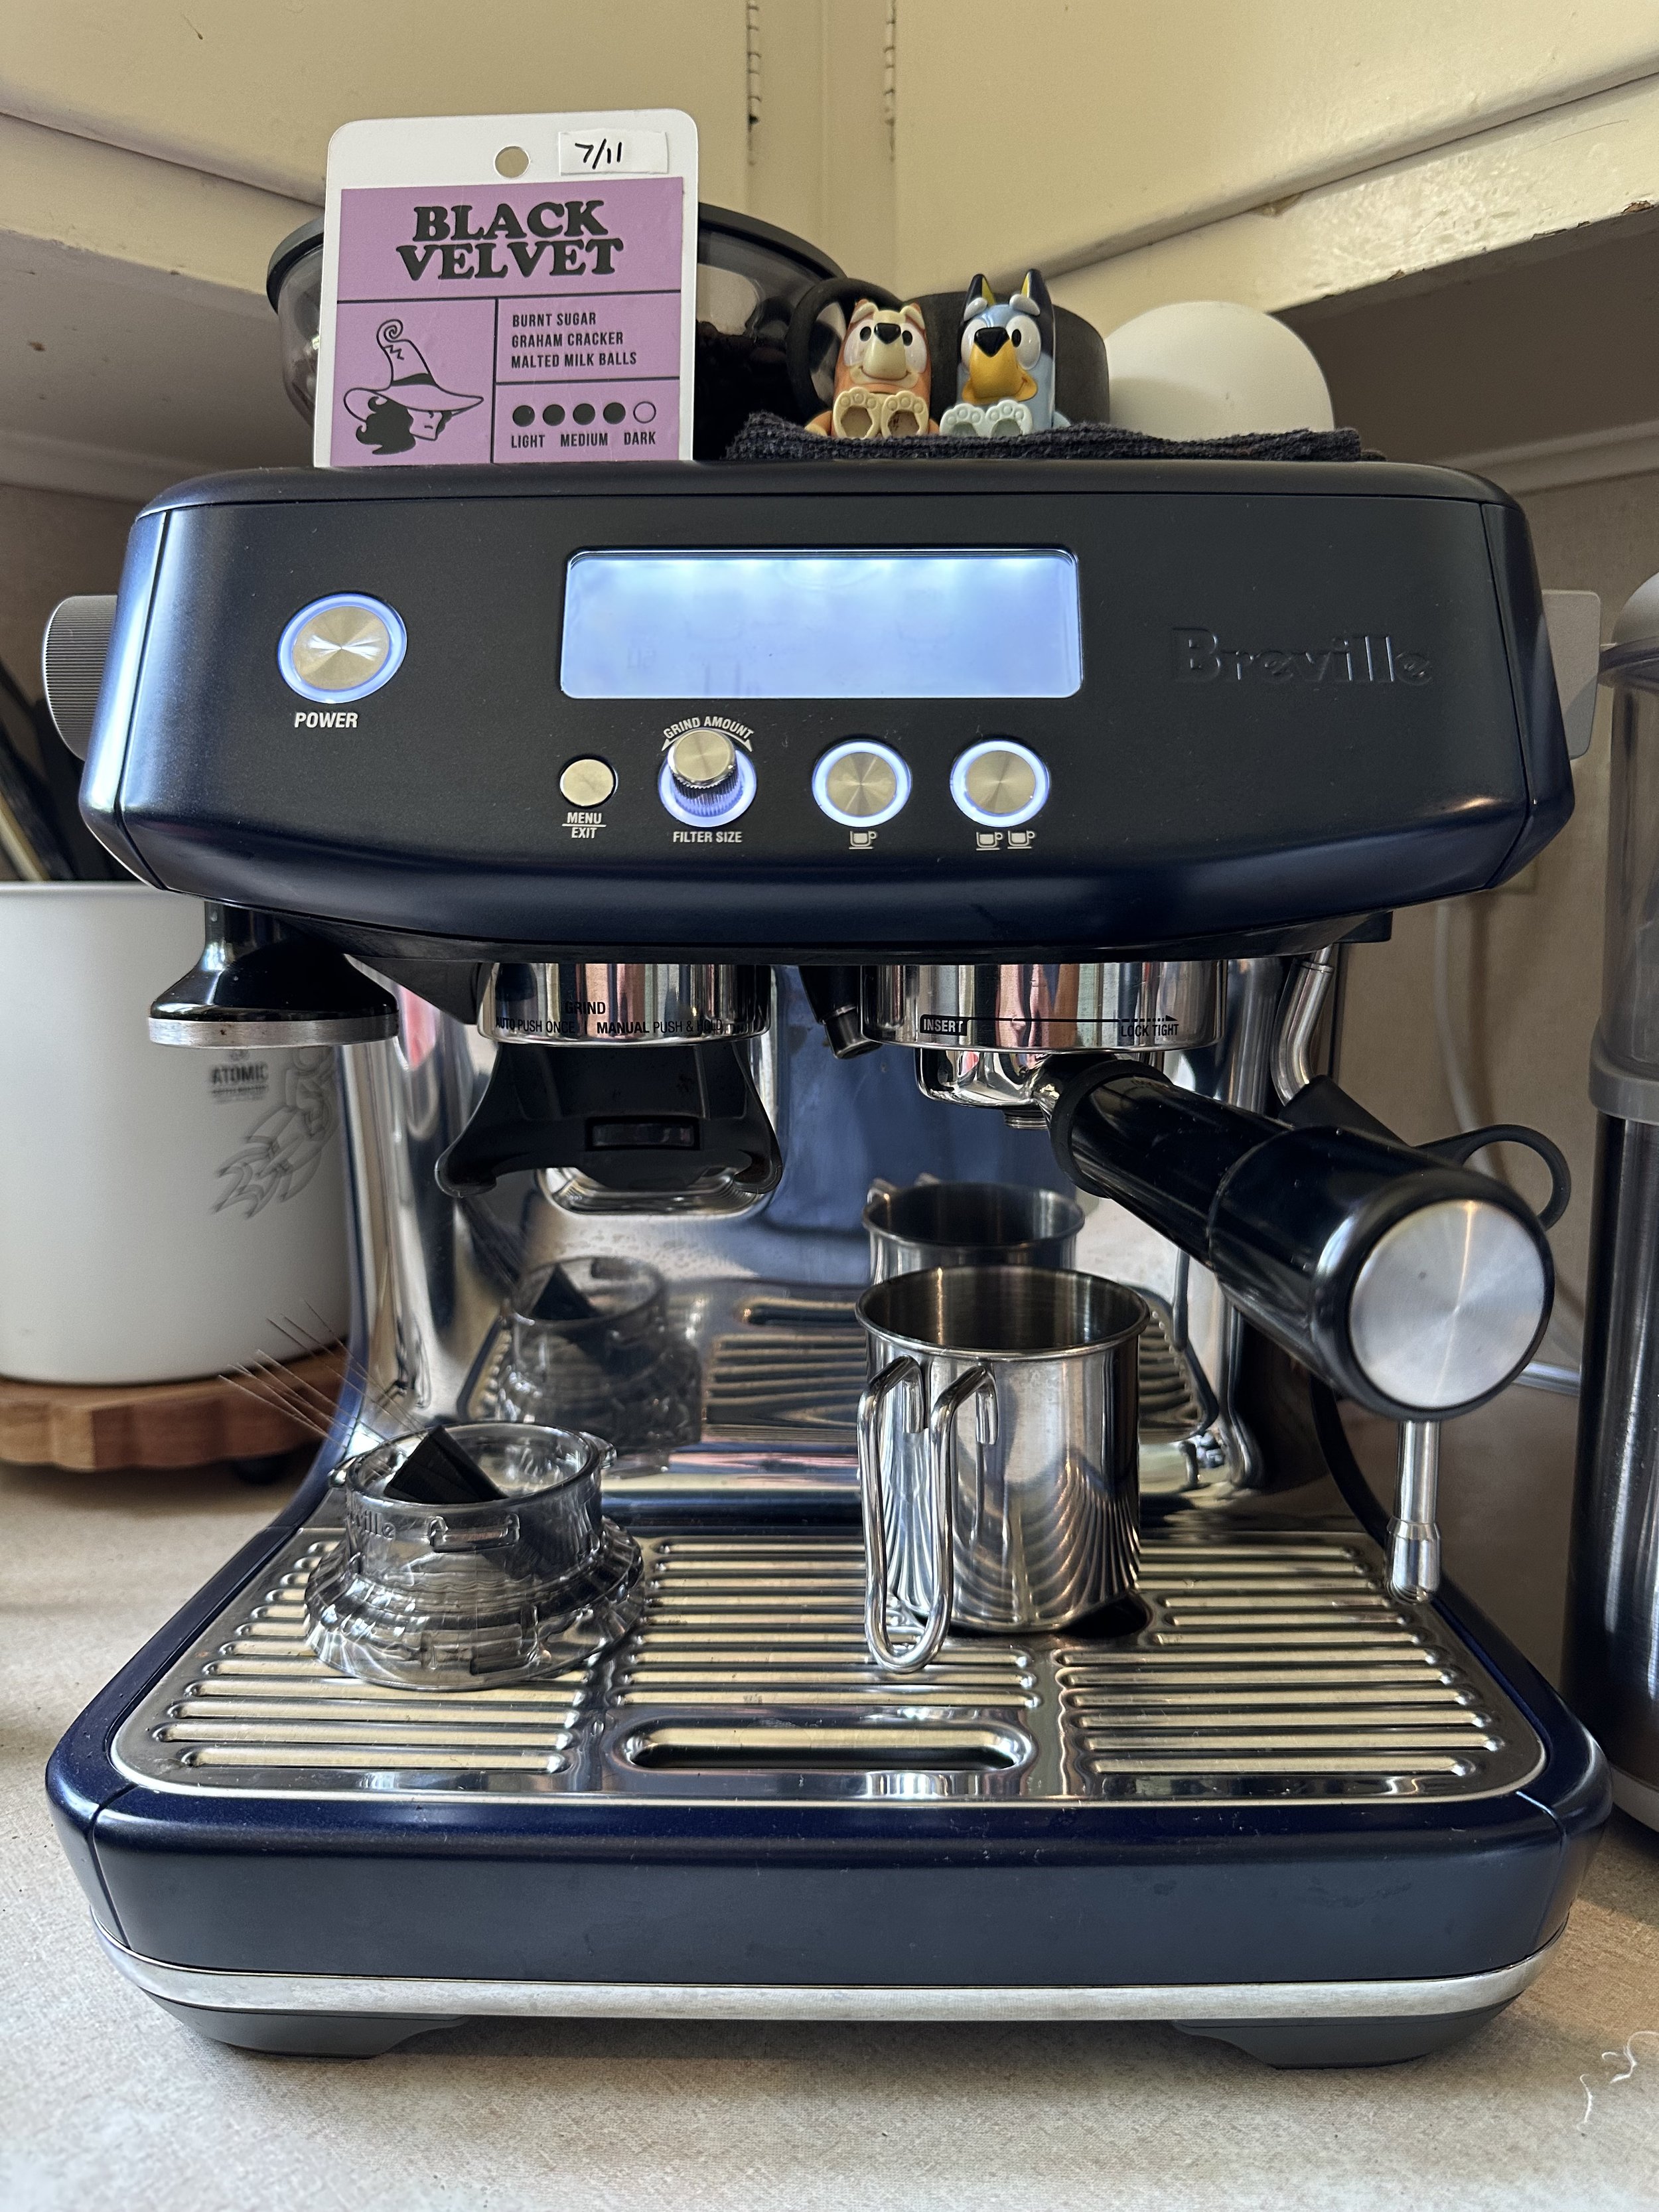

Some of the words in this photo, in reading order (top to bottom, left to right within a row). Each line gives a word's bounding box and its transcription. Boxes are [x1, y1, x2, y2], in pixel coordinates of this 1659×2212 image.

[574, 139, 622, 169] 7/11
[412, 200, 609, 242] BLACK
[396, 238, 624, 281] VELVET
[512, 313, 552, 327] BURNT
[557, 312, 596, 326] SUGAR
[512, 334, 563, 348] GRAHAM
[567, 332, 623, 346] CRACKER
[511, 354, 559, 369] MALTED
[564, 354, 594, 367] MILK
[599, 352, 637, 366] BALLS
[510, 433, 545, 449] LIGHT
[560, 432, 608, 447] MEDIUM
[624, 431, 656, 445] DARK
[1171, 627, 1433, 686] Breville
[294, 711, 358, 729] POWER
[663, 717, 701, 739] GRIND
[703, 715, 755, 739] AMOUNT
[567, 812, 602, 825] MENU
[571, 826, 597, 839] EXIT
[673, 831, 713, 843] FILTER
[717, 831, 742, 843] SIZE
[564, 1001, 606, 1015] GRIND
[496, 1017, 516, 1030] AUTO
[518, 1019, 542, 1033] PUSH
[545, 1020, 575, 1034] ONCE
[597, 1021, 650, 1034] MANUAL
[653, 1020, 683, 1033] PUSH
[685, 1019, 693, 1033] &
[697, 1019, 722, 1032] HOLD
[923, 1017, 964, 1033] INSERT
[1121, 1024, 1149, 1037] LOCK
[1152, 1023, 1179, 1037] TIGHT
